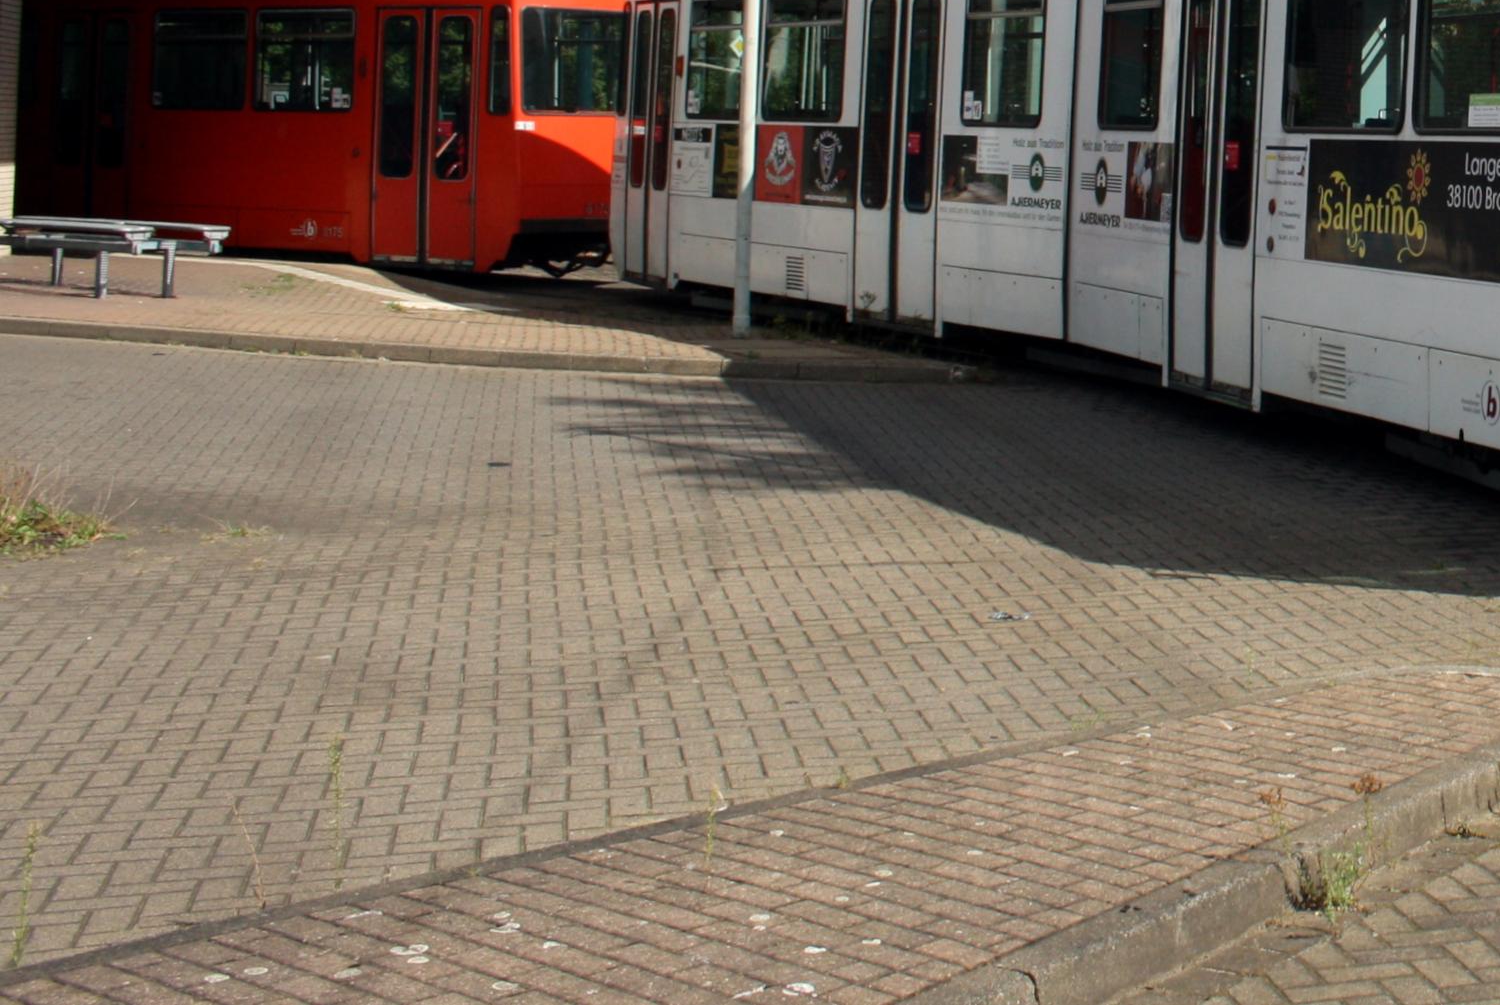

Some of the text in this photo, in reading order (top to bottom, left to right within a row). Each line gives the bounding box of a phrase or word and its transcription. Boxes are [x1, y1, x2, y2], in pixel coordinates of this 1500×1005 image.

[1039, 138, 1065, 150] Tradition
[1446, 184, 1483, 211] 38100
[1318, 176, 1427, 251] Salentino
